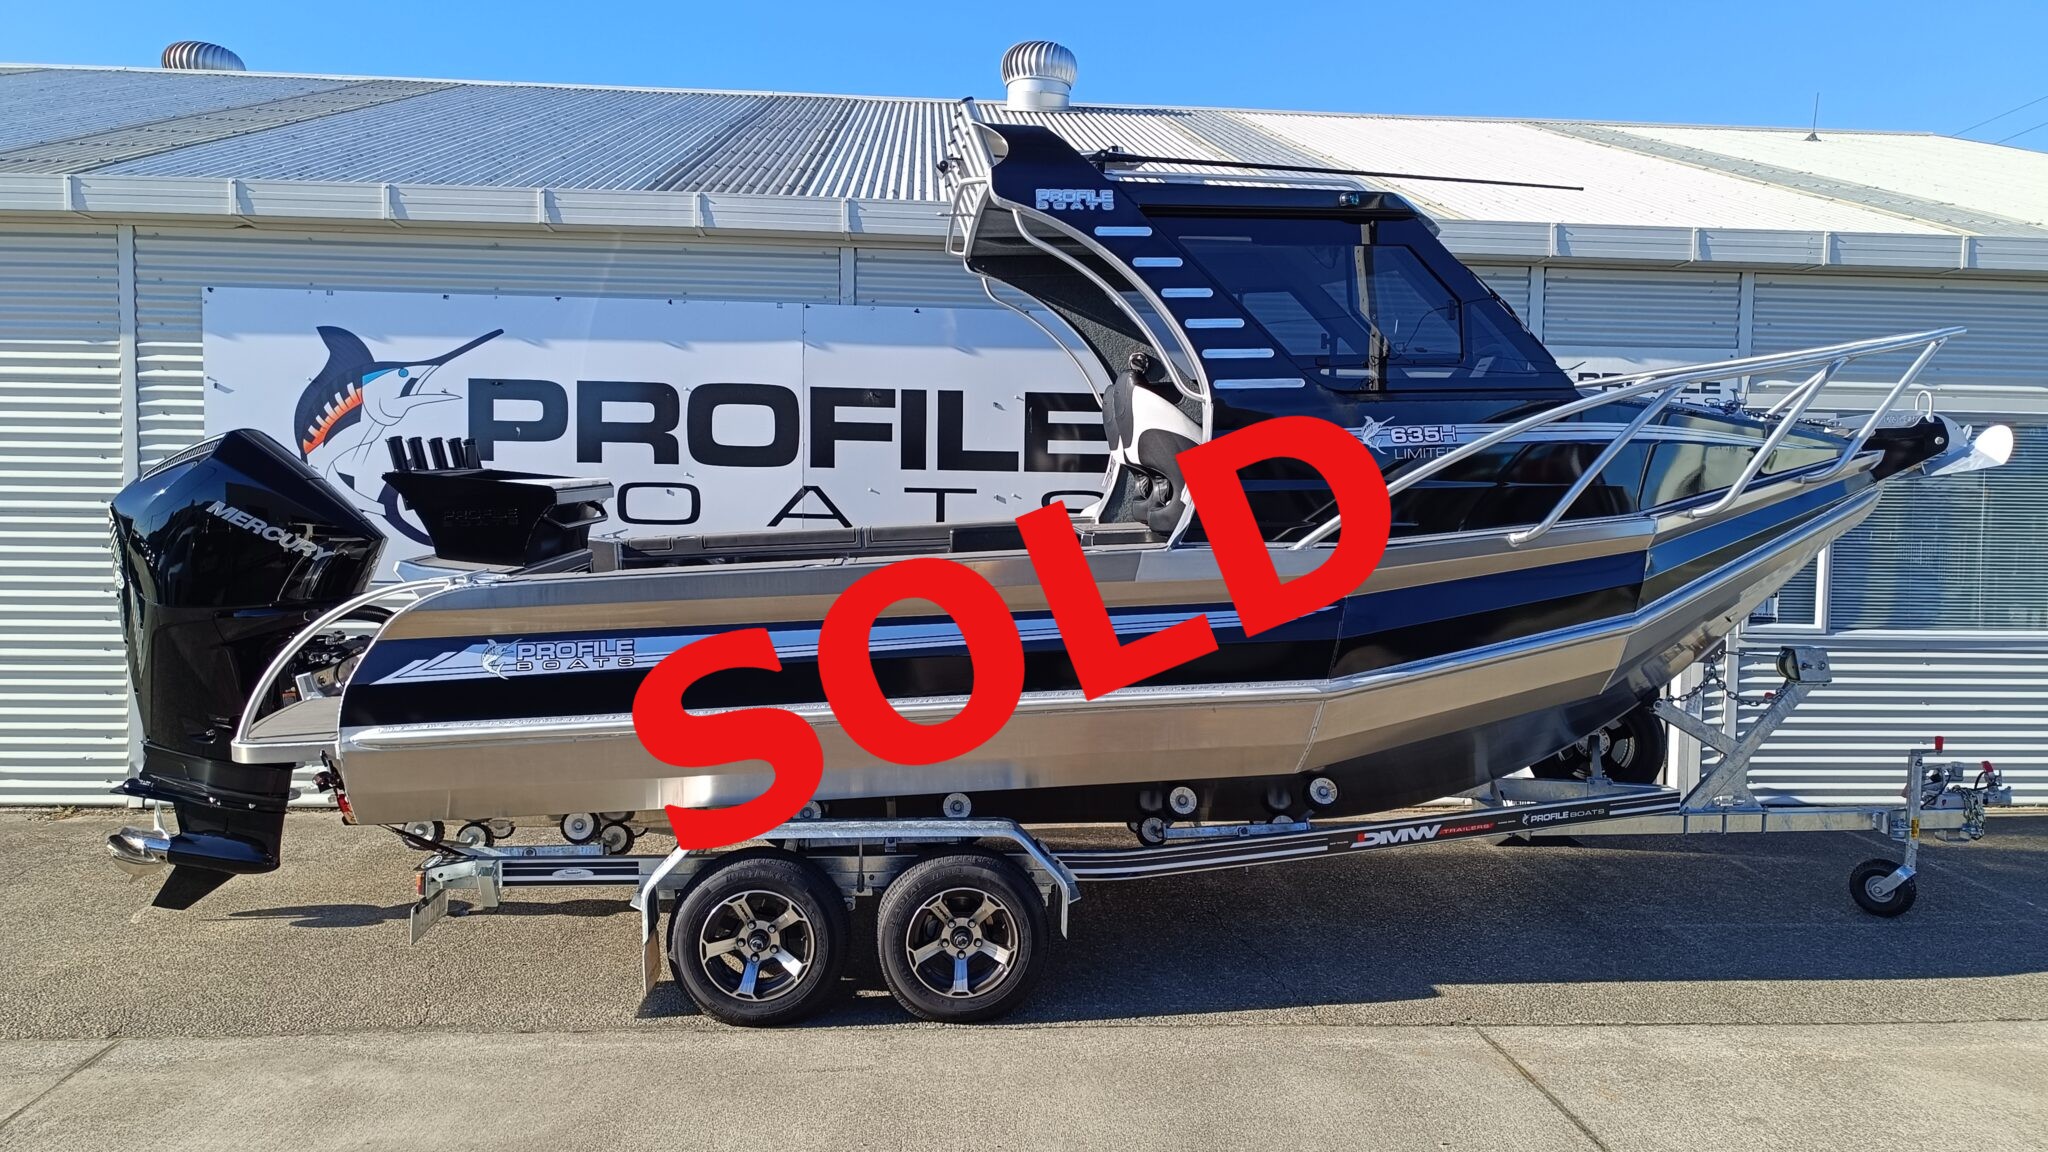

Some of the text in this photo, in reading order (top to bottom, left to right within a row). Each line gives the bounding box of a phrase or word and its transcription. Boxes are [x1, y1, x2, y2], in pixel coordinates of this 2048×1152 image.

[1036, 188, 1114, 203] PROFILE
[1036, 201, 1115, 210] BOATS
[468, 378, 1111, 473] PROFILE
[1390, 425, 1458, 444] 635H
[617, 481, 1105, 528] OAT
[206, 500, 336, 562] MERCURY
[516, 639, 635, 661] PROFILE
[516, 656, 635, 672] BOATS
[1530, 811, 1569, 823] PROFILE
[1570, 808, 1605, 818] BOATS
[1349, 823, 1491, 849] DMW TRAILERS
